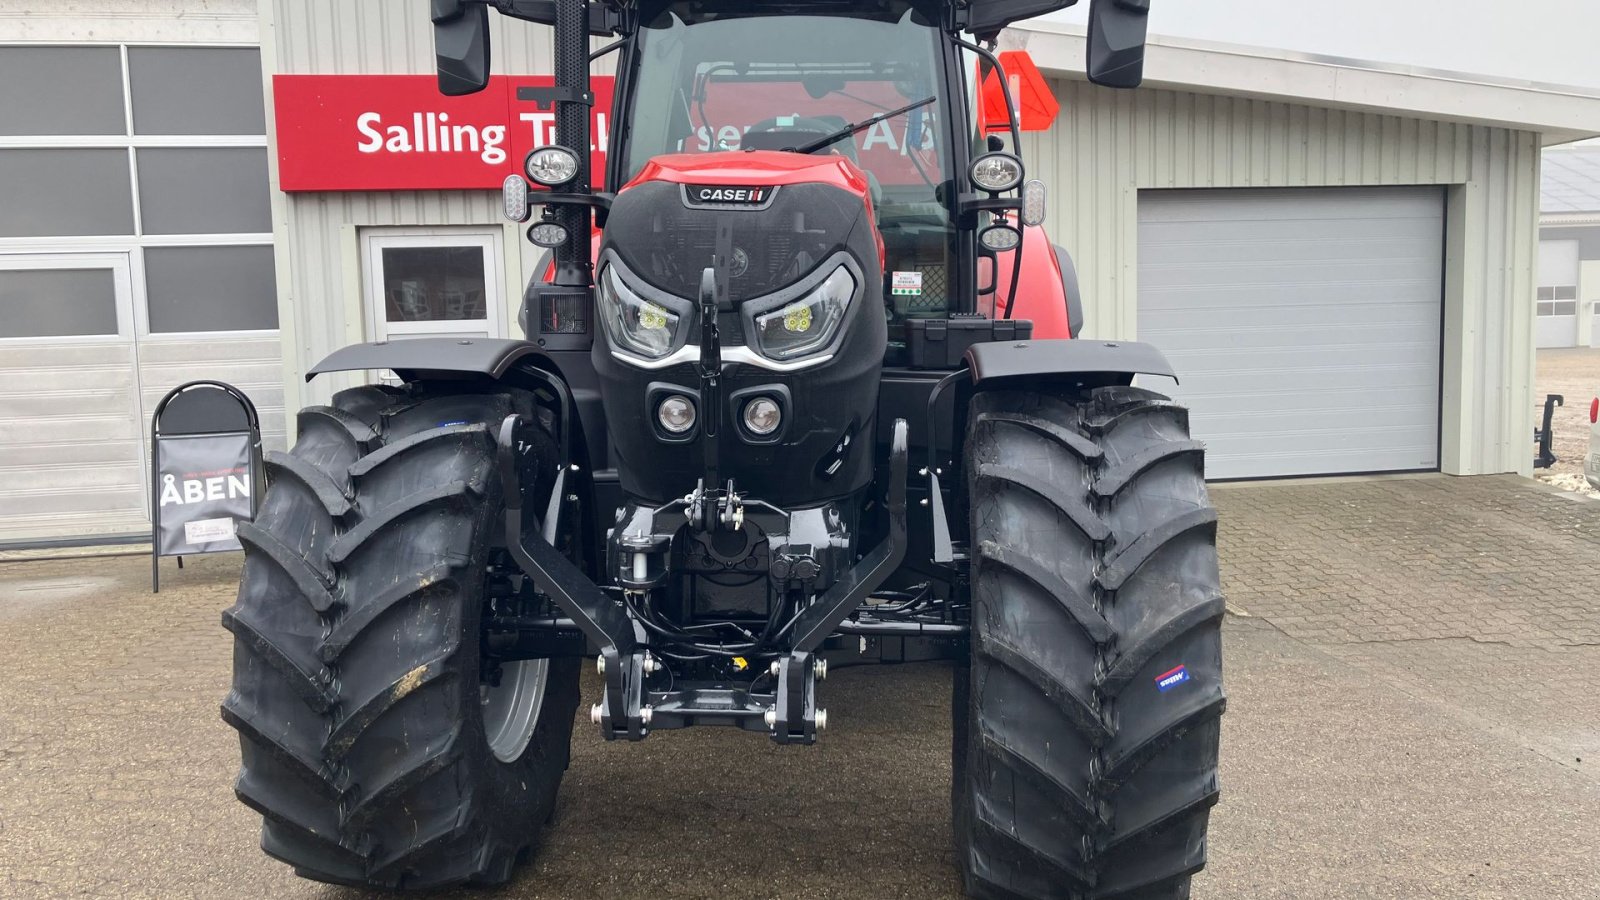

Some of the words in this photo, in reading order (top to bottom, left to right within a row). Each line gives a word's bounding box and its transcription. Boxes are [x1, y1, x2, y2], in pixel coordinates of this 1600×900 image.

[357, 112, 507, 165] Salling
[700, 188, 746, 201] CASE
[160, 473, 250, 507] ÅBEN
